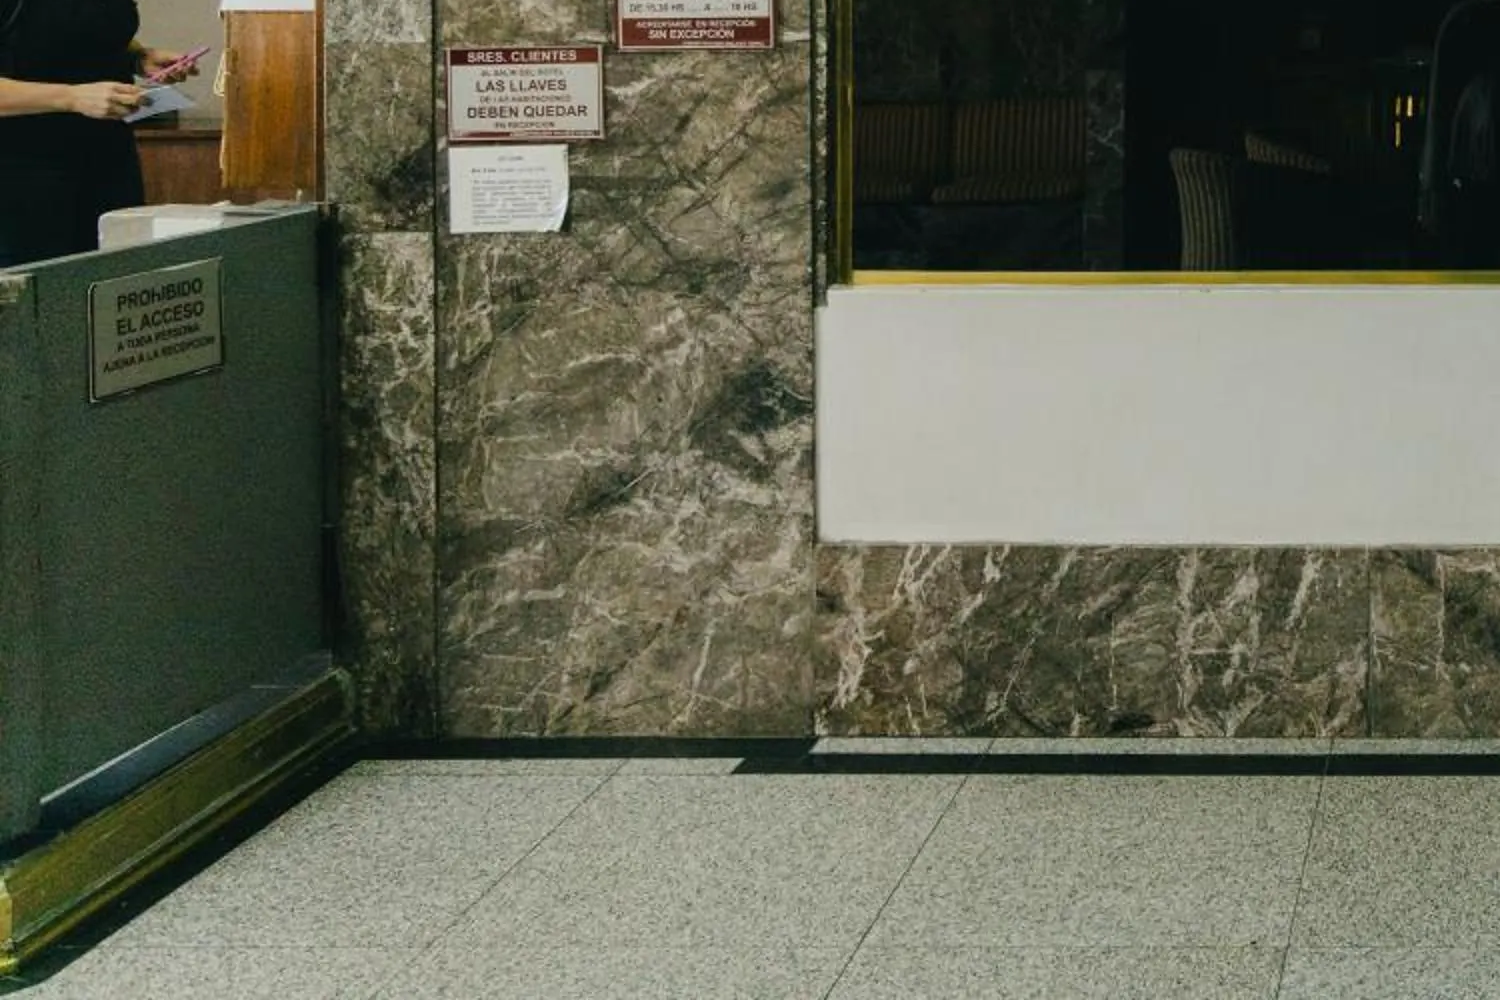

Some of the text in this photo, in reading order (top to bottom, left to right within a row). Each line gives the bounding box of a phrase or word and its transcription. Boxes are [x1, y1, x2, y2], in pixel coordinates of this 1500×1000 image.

[629, 3, 643, 12] DE
[704, 3, 711, 11] A
[743, 2, 758, 11] HS
[696, 20, 708, 28] EN
[648, 29, 667, 39] SIN
[467, 50, 577, 63] SRES. CLIENTES
[475, 79, 567, 92] LAS LLAVES
[467, 105, 588, 119] DEBEN QUEDAR
[116, 277, 203, 312] PROHIBIDO
[116, 300, 205, 336] EL ACCESO
[117, 341, 125, 352] A
[154, 322, 200, 341] PERSONA
